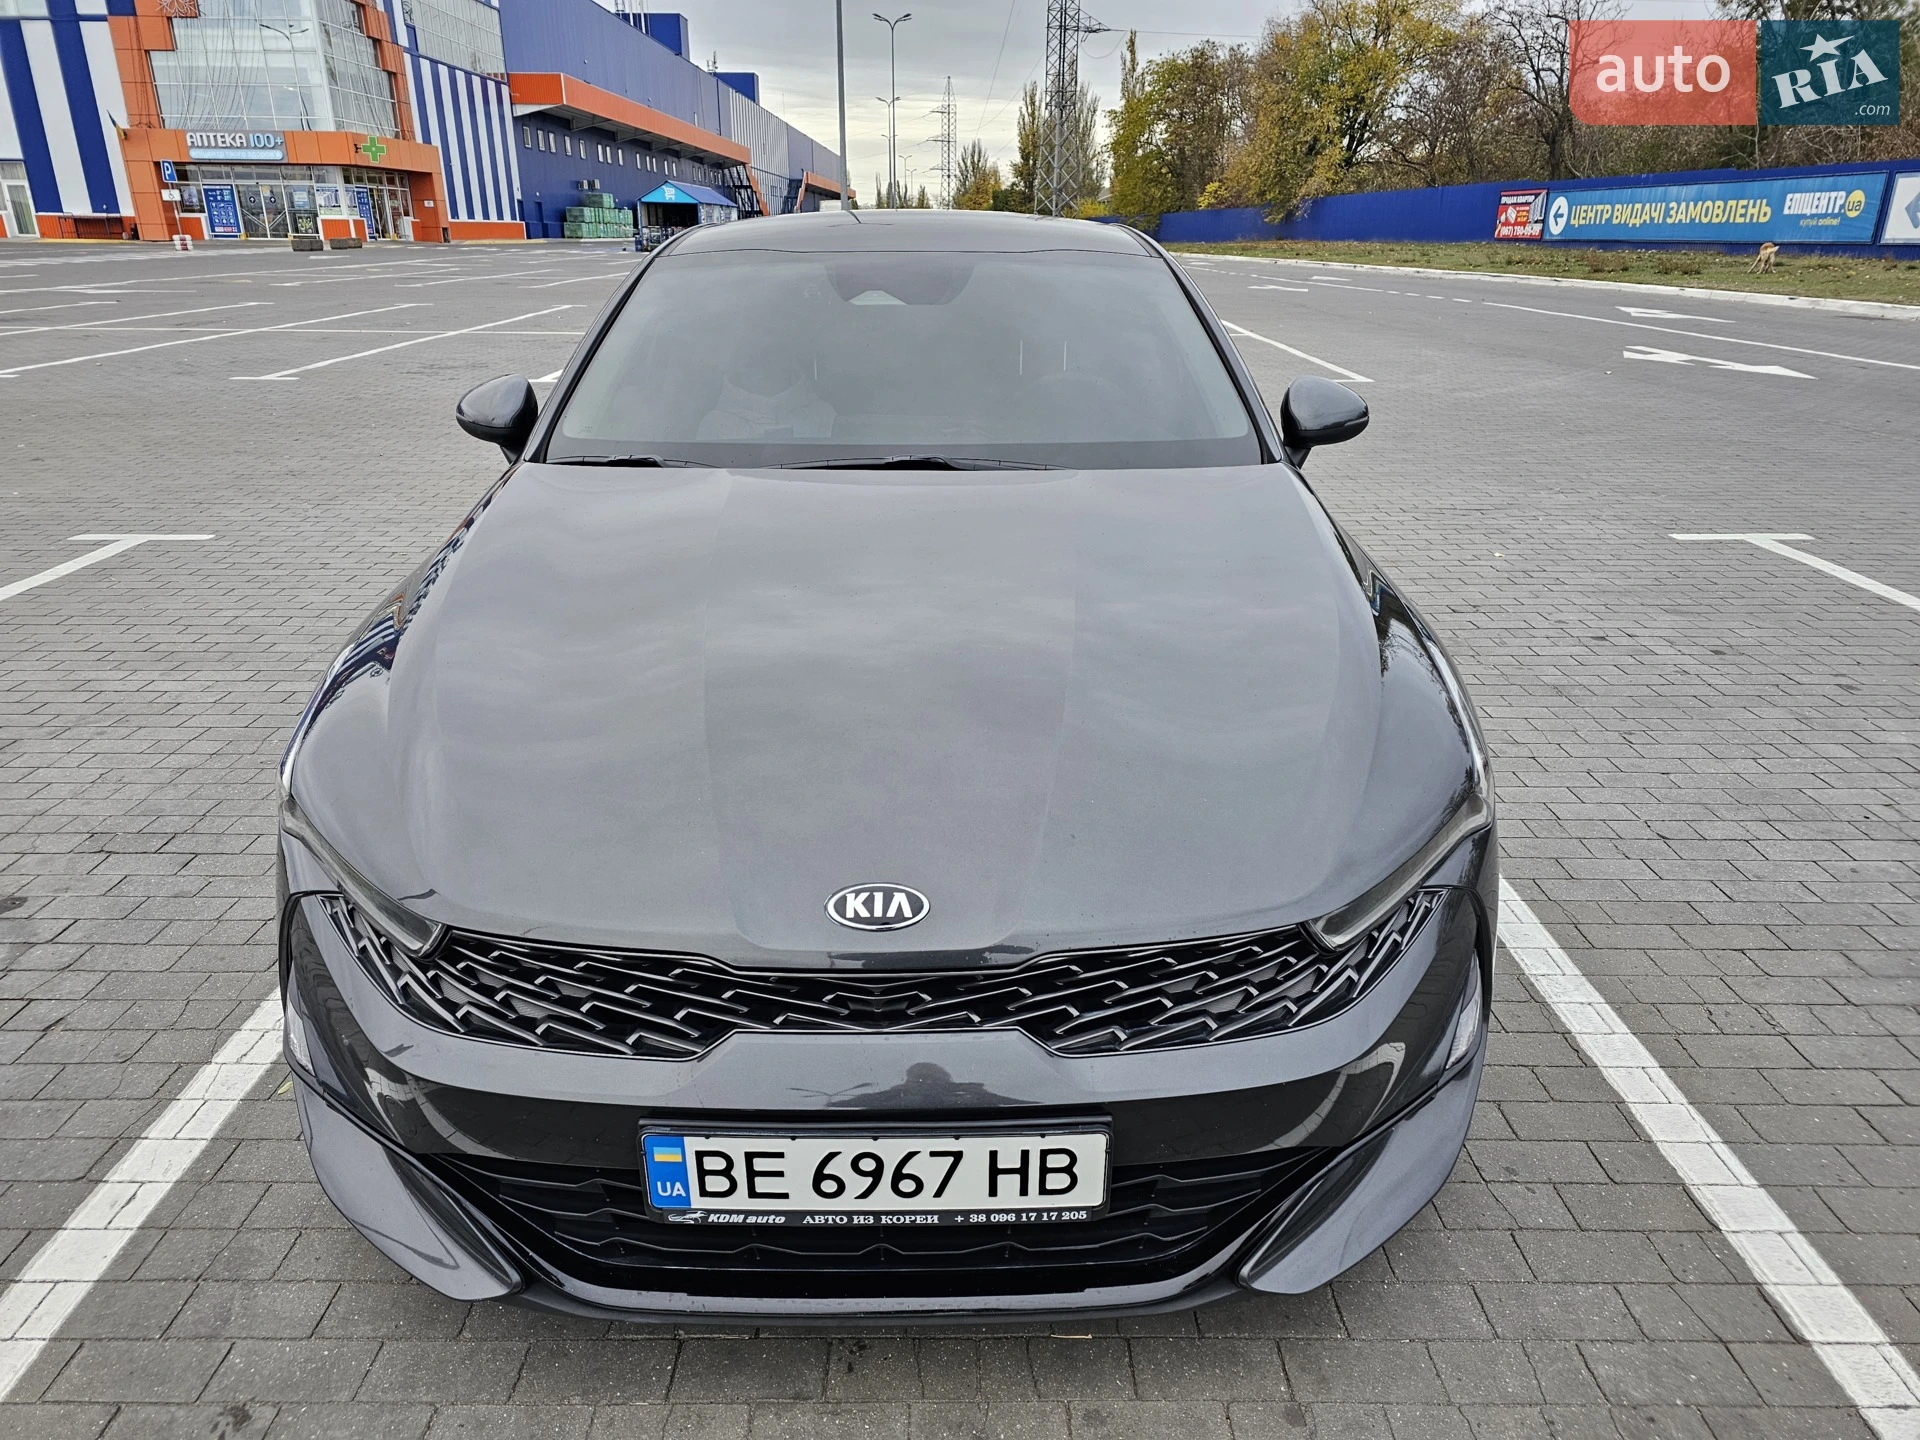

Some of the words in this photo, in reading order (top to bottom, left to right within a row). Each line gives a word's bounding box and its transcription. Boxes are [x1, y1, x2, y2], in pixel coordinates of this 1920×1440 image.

[186, 132, 247, 147] АПТЕКА
[249, 133, 284, 148] 100+
[1570, 204, 1611, 227] ЦЕНТР
[1612, 202, 1665, 228] ВИДАЧІ
[1666, 199, 1772, 225] ЗАМОВЛЕНЬ
[1818, 216, 1841, 226] online!
[846, 892, 913, 918] KIA
[694, 1150, 790, 1201] BE
[811, 1149, 964, 1200] 6967
[988, 1148, 1078, 1198] HB
[657, 1181, 686, 1198] UA
[708, 1213, 744, 1224] KDM
[745, 1214, 786, 1224] auto
[802, 1214, 848, 1225] АВТО
[852, 1214, 874, 1225] ИЗ
[969, 1213, 987, 1223] 38
[990, 1213, 1017, 1223] 096
[1020, 1212, 1036, 1222] 17
[1041, 1212, 1057, 1222] 17
[1061, 1211, 1087, 1222] 205
